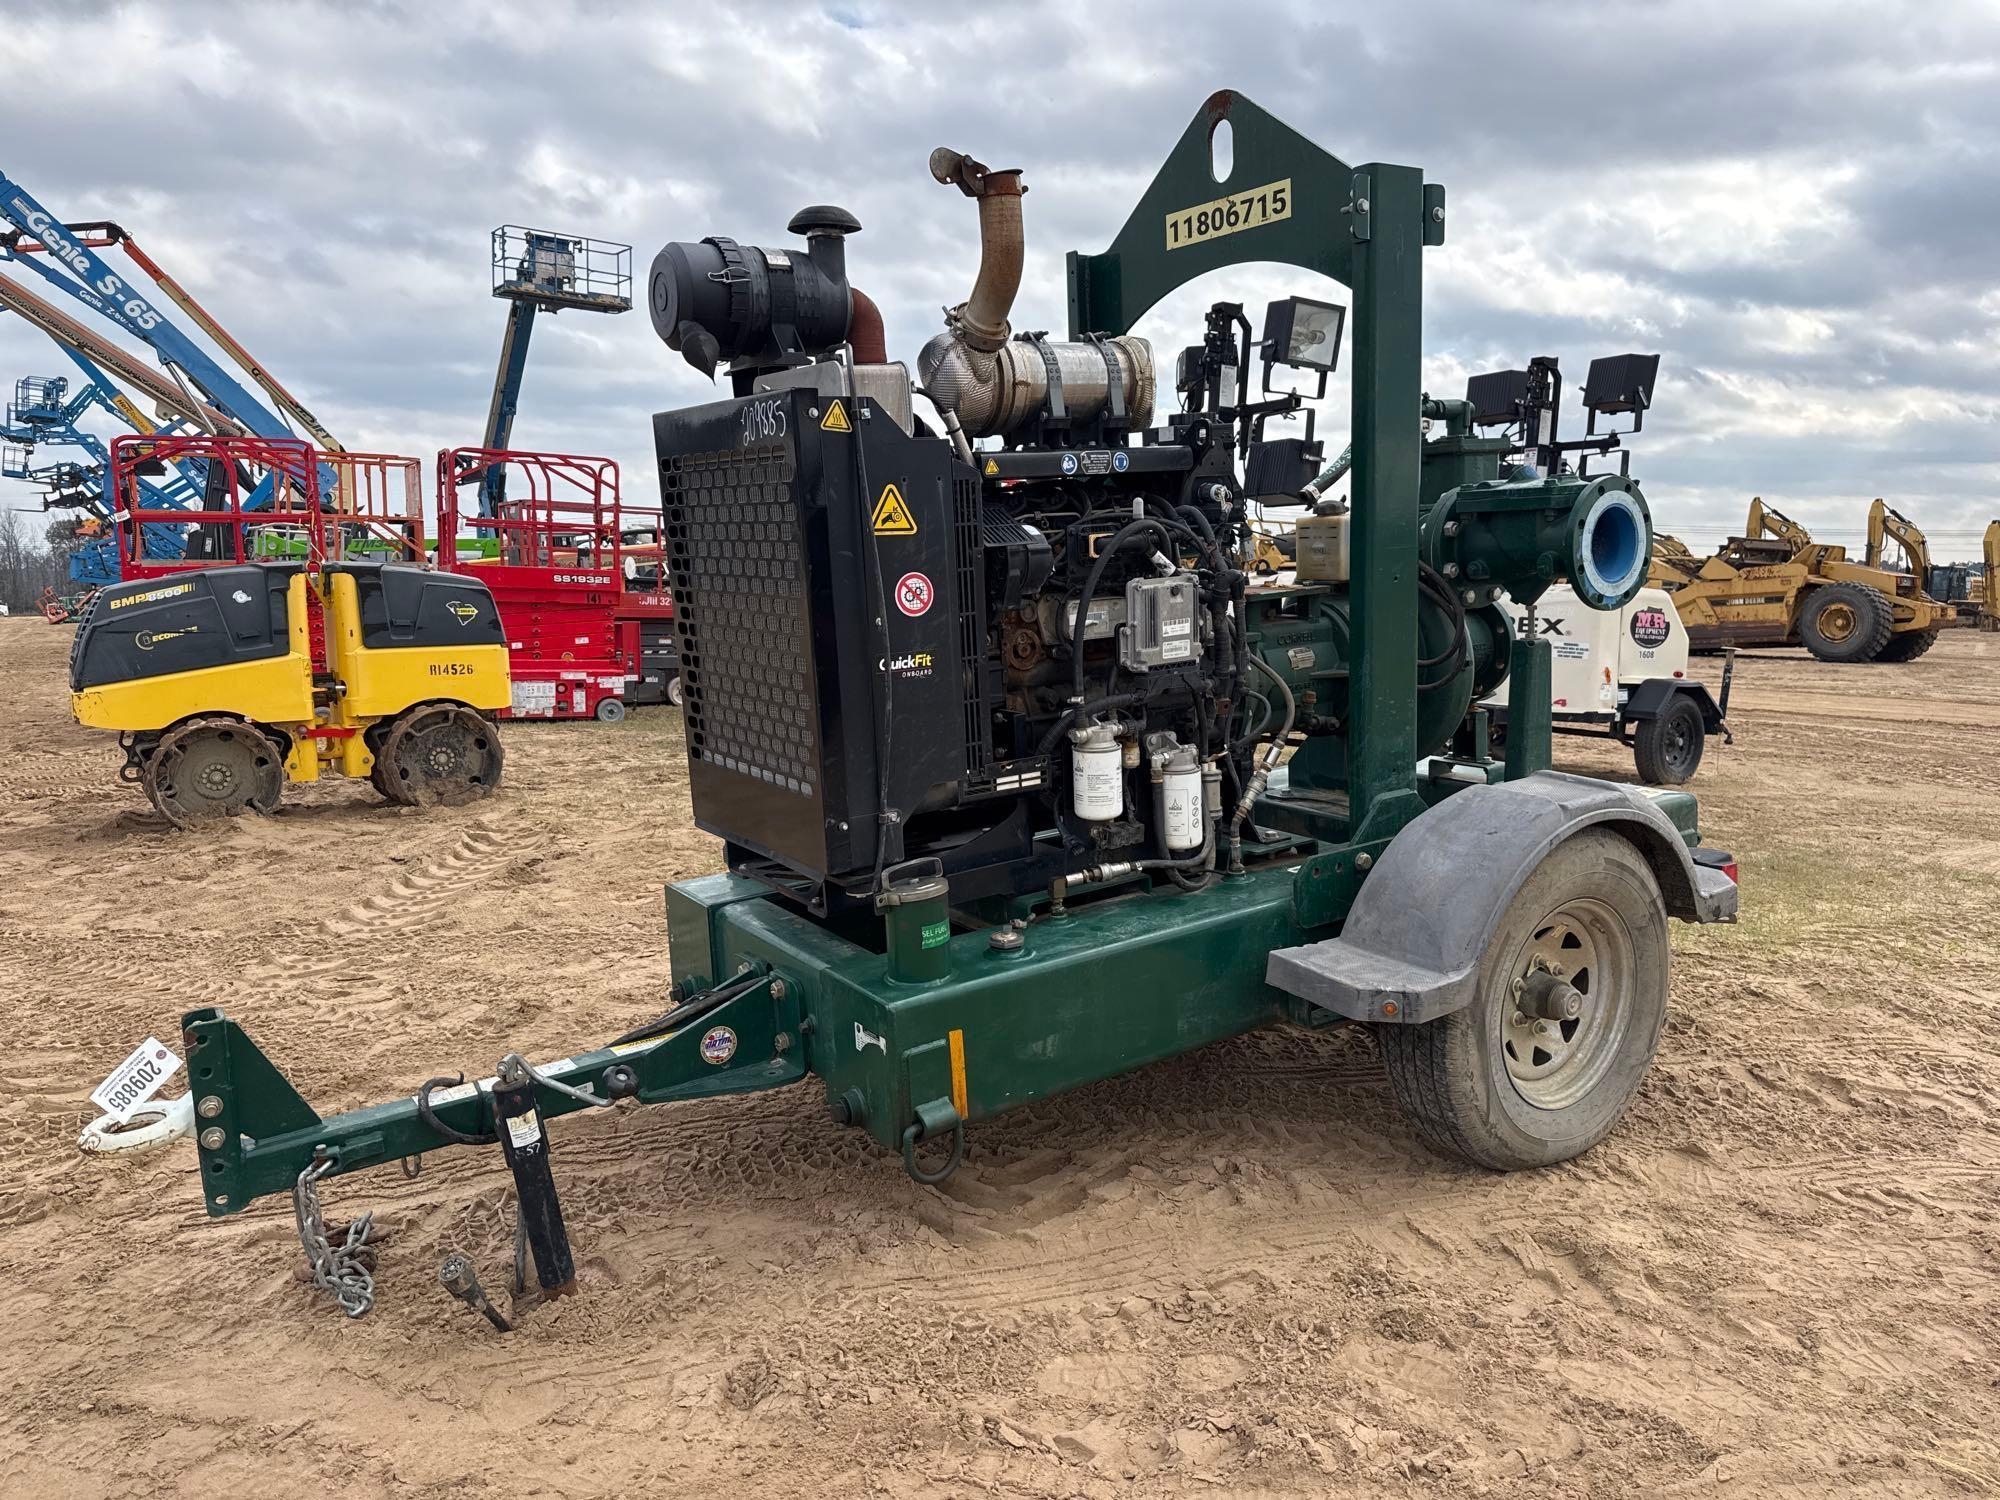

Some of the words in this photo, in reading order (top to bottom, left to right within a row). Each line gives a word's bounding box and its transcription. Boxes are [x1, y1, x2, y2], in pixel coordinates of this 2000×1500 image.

[1169, 188, 1287, 243] 11806715
[26, 211, 91, 276] Genie
[97, 275, 164, 330] S-65
[740, 399, 787, 447] 209885
[553, 574, 611, 584] SS1932E
[1635, 627, 1666, 636] EQUIPMENT
[1639, 650, 1655, 659] 1608
[901, 668, 933, 678] ONBOARD
[108, 1060, 162, 1112] 209885
